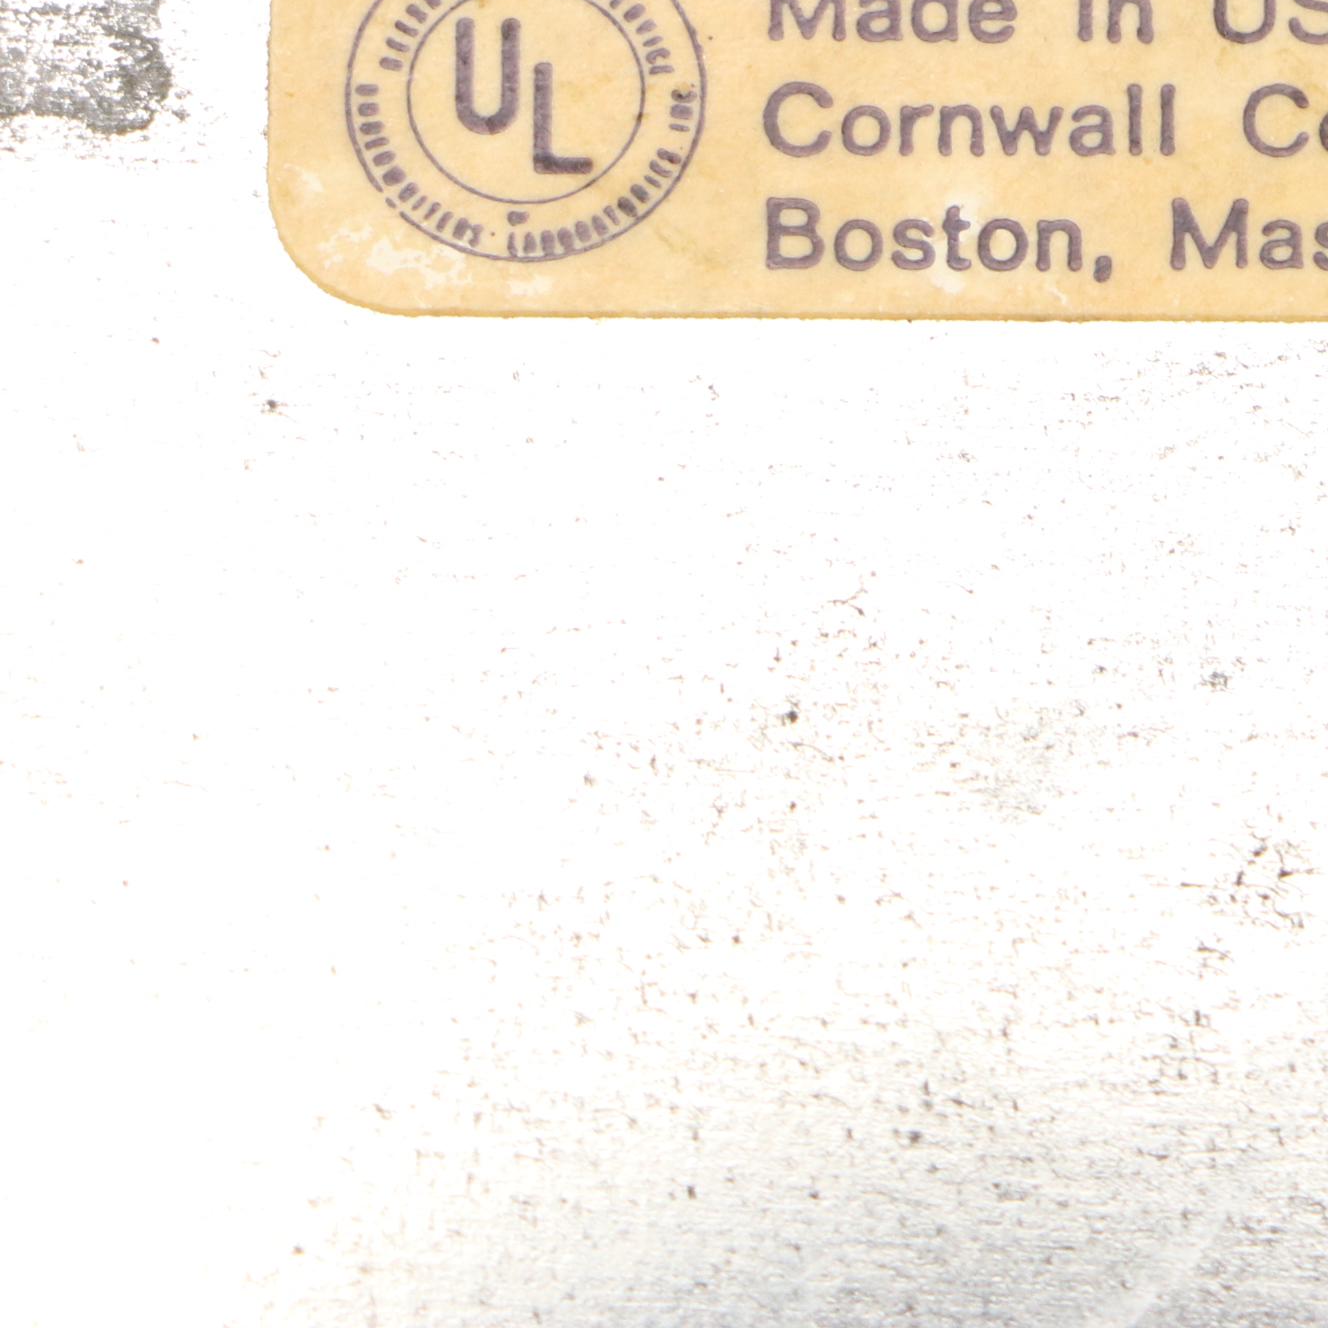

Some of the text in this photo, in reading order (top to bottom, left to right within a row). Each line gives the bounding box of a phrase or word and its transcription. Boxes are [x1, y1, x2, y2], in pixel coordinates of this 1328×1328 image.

[455, 19, 593, 174] UL
[763, 82, 1174, 157] Cornwall
[767, 198, 1112, 282] Boston,
